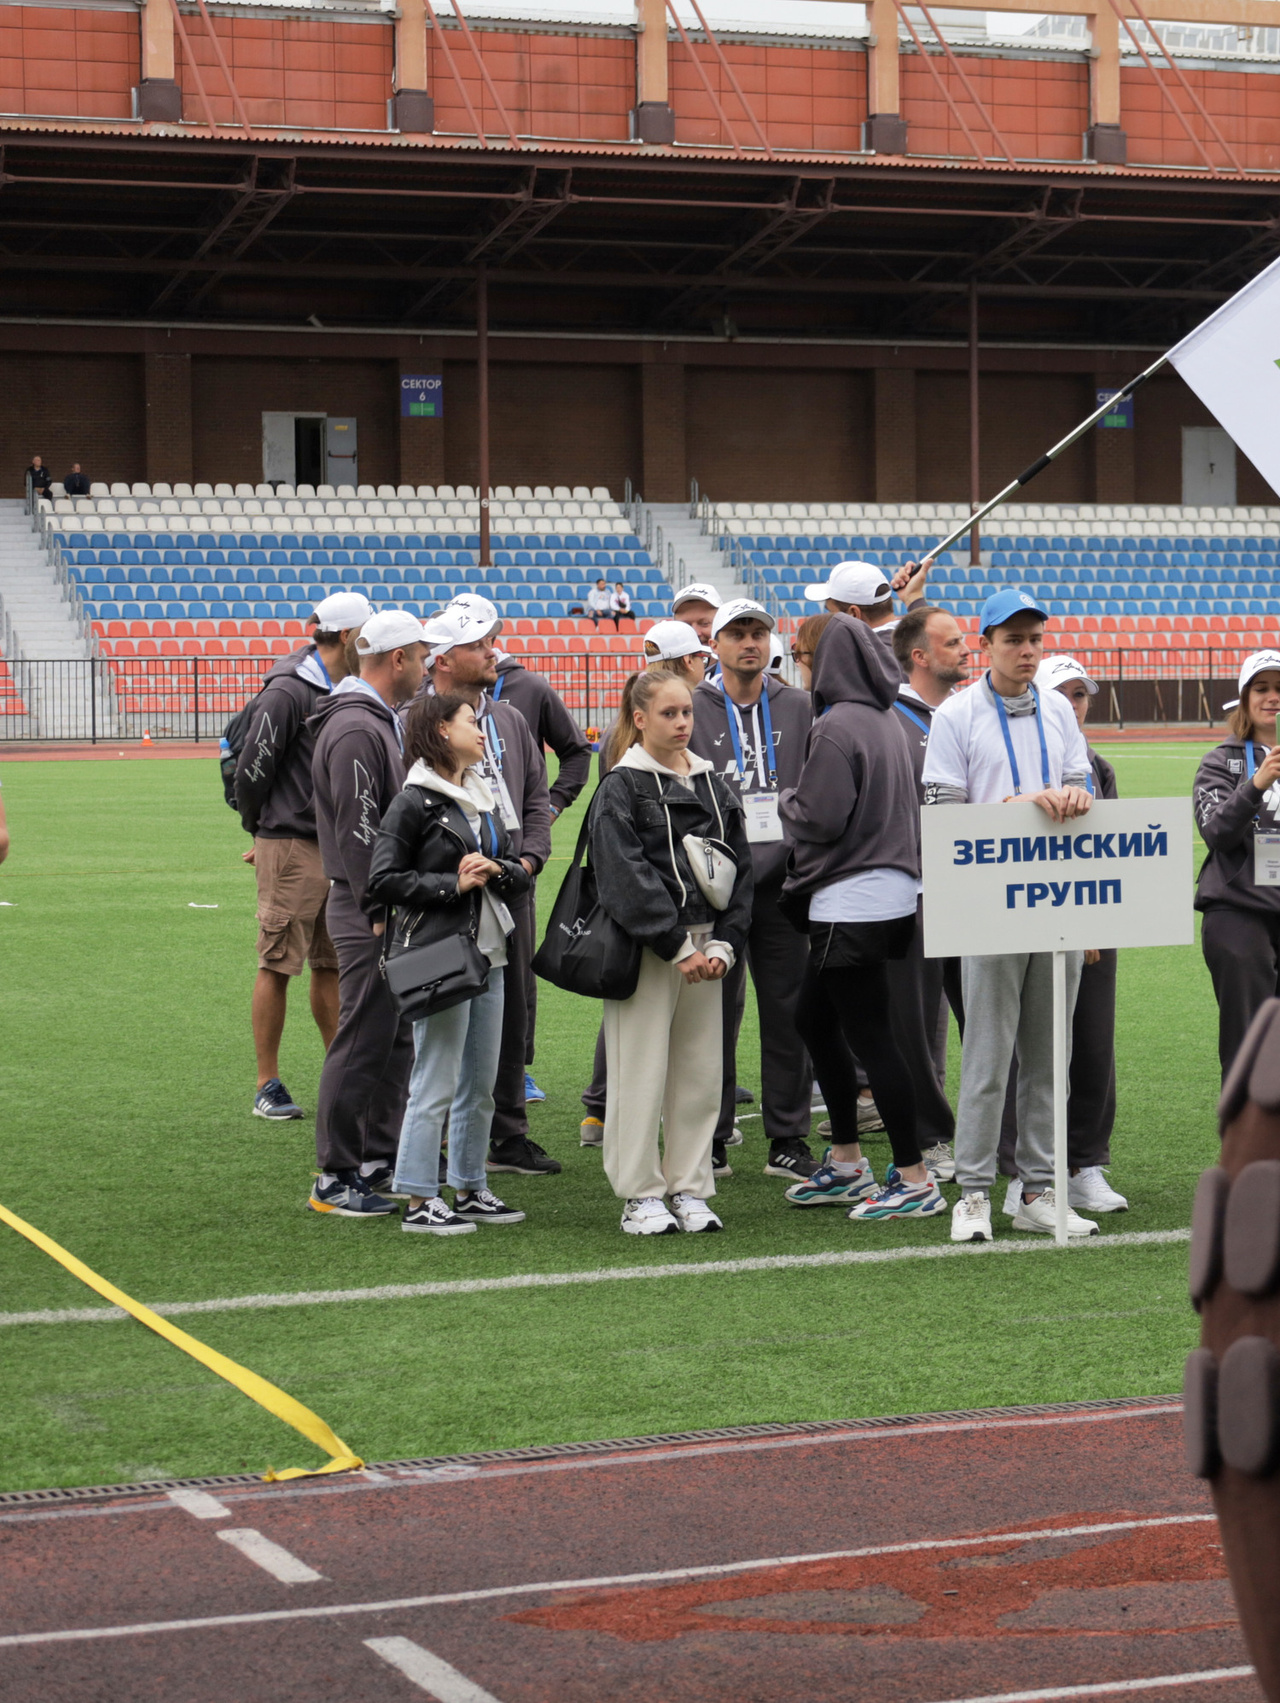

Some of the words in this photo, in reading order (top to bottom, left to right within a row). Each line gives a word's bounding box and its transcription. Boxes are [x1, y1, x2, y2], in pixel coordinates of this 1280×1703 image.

[401, 379, 442, 390] СЕКТОР
[419, 391, 426, 402] 6
[953, 824, 1168, 865] ЗЕЛИНСКИЙ
[1006, 879, 1122, 909] ГРУПП
